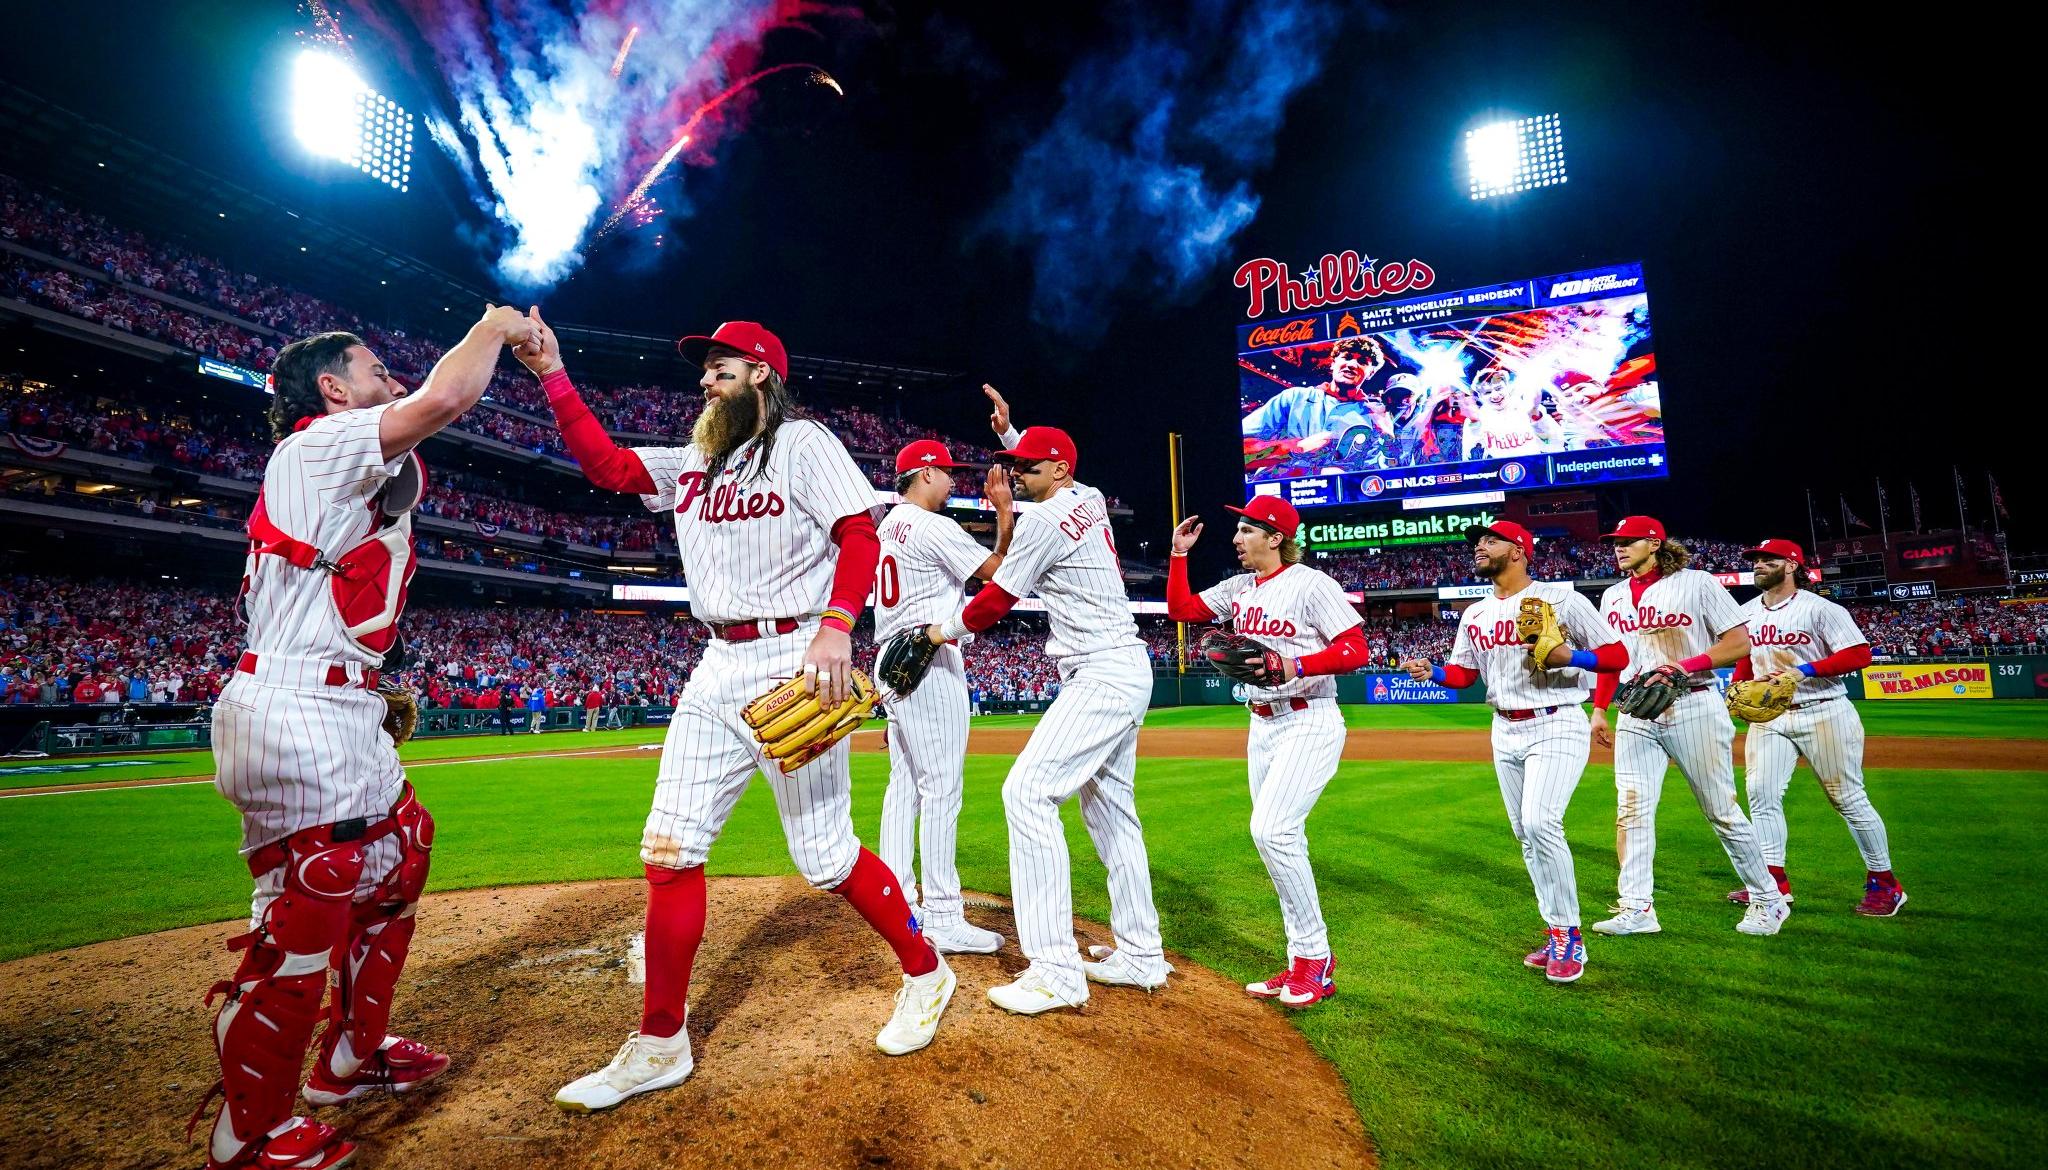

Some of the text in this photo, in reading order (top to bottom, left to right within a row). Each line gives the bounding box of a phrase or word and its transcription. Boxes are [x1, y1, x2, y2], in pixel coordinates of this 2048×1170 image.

[1233, 250, 1435, 318] Phillies
[1362, 287, 1524, 320] SALTZ MONGELUZZI BENDESKY
[1363, 309, 1452, 329] TRIAL LAWYERS
[1248, 318, 1317, 348] Coca-Cola
[1557, 456, 1646, 473] Independence
[1404, 475, 1436, 488] NLCS
[675, 470, 785, 523] Phllies
[1310, 523, 1388, 543] Citizens
[1392, 515, 1444, 538] Bank
[1447, 511, 1495, 533] Park
[1903, 545, 1956, 560] GIANT
[1231, 601, 1297, 638] Phillies
[1607, 605, 1693, 635] Phillies
[1467, 619, 1526, 652] Phill
[1749, 624, 1811, 647] hillies
[1867, 671, 1903, 681] WHO BUT
[1998, 665, 2023, 676] 387
[766, 689, 795, 712] A2000
